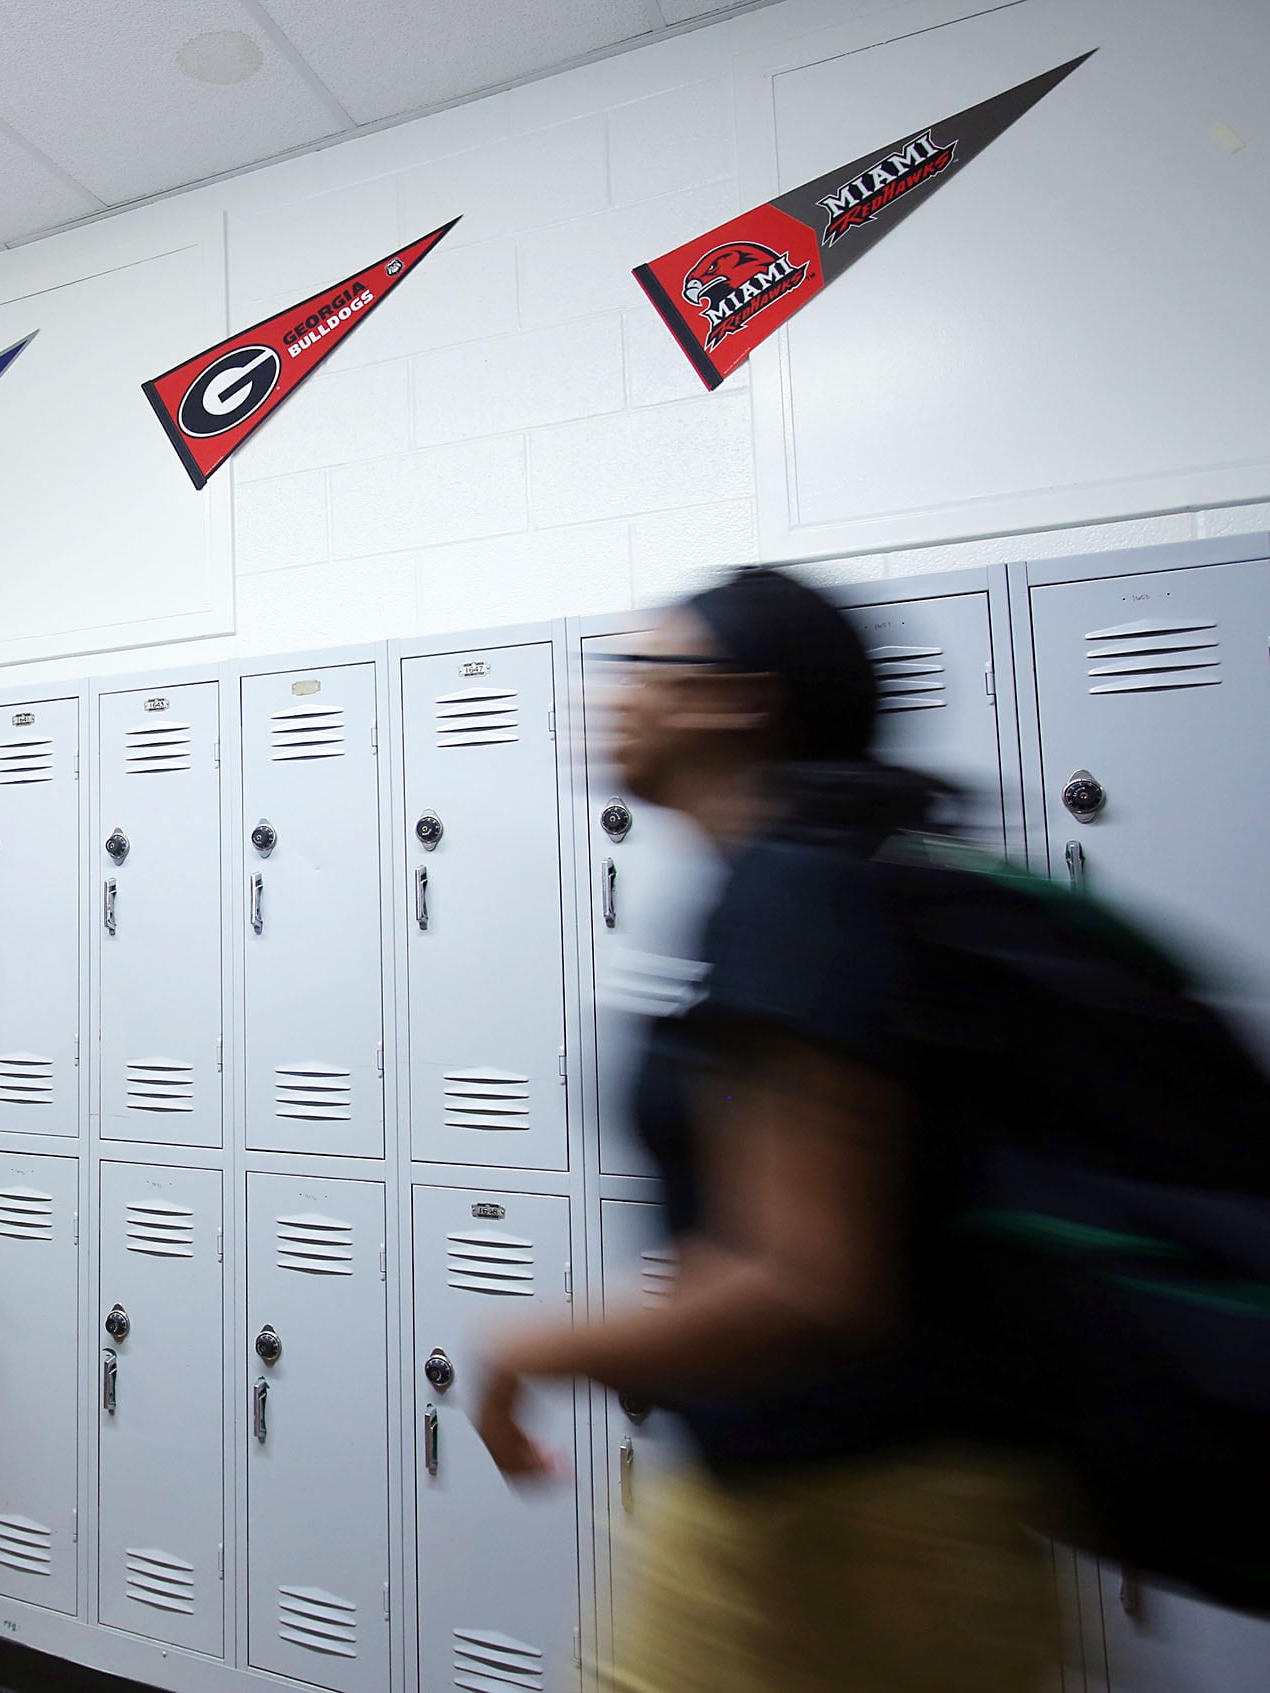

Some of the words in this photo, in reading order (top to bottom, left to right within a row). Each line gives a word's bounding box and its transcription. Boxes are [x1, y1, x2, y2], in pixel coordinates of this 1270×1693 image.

[822, 134, 938, 218] MIAMI
[282, 281, 368, 346] GEORGIA
[287, 289, 374, 358] BULLDOGS
[705, 256, 794, 326] MIAMI
